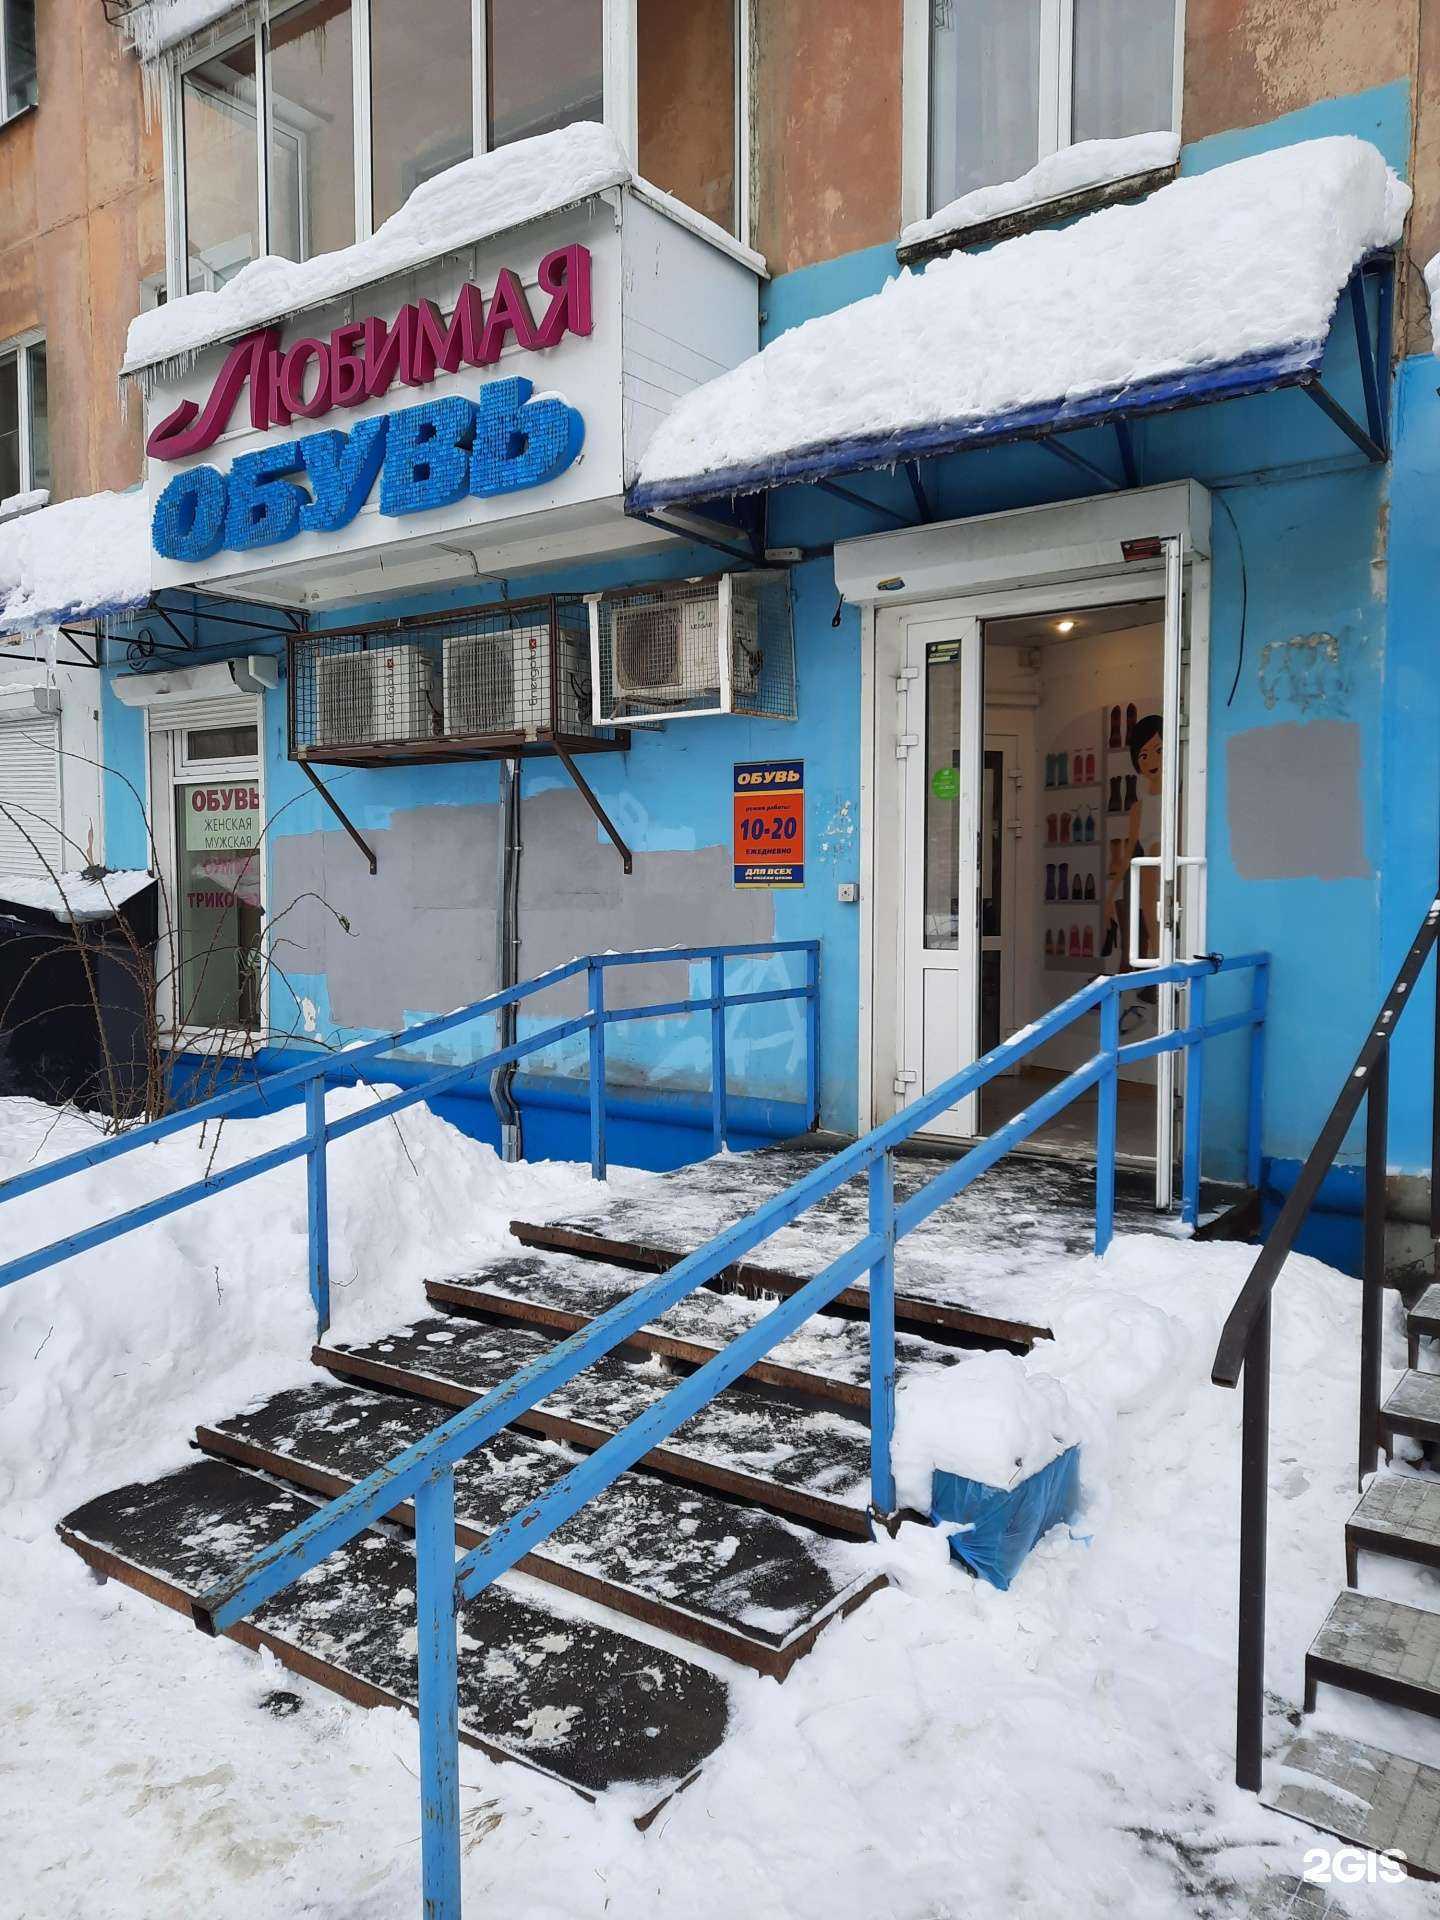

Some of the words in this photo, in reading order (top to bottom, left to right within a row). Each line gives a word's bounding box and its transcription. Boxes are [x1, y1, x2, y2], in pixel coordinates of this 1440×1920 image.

[146, 242, 592, 461] ЛЮБИМАЯ
[151, 376, 586, 562] ОБУВЬ
[738, 770, 801, 785] ОБУВЬ
[192, 788, 259, 812] ОБУВЬ
[205, 818, 252, 831] ЖЕНСКАЯ
[741, 816, 797, 840] 10-20
[205, 836, 252, 848] МУЖСКАЯ
[745, 868, 766, 876] ДЛЯ
